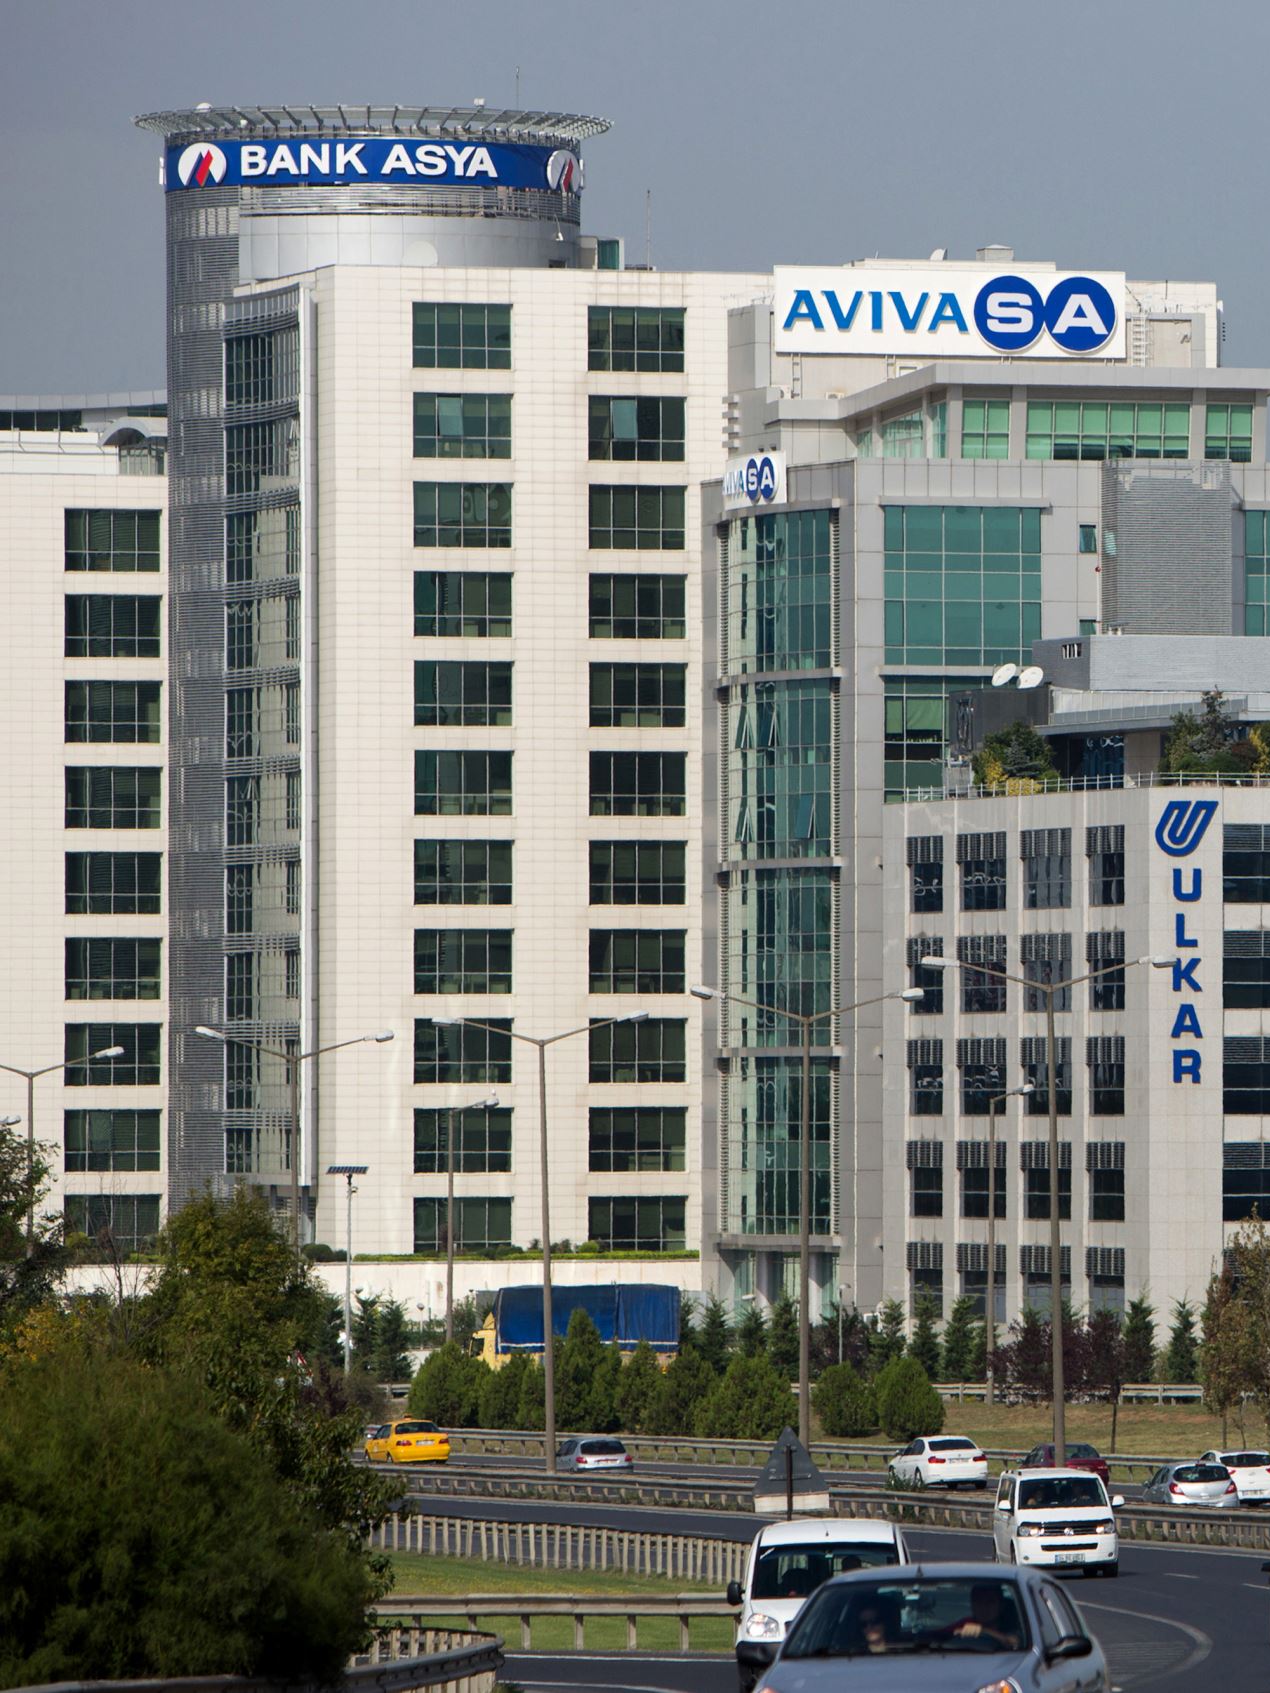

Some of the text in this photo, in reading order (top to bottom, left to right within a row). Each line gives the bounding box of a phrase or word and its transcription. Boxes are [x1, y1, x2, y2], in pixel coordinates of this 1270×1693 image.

[240, 143, 498, 179] BANK ASYA
[1171, 867, 1203, 1084] ULKAR
